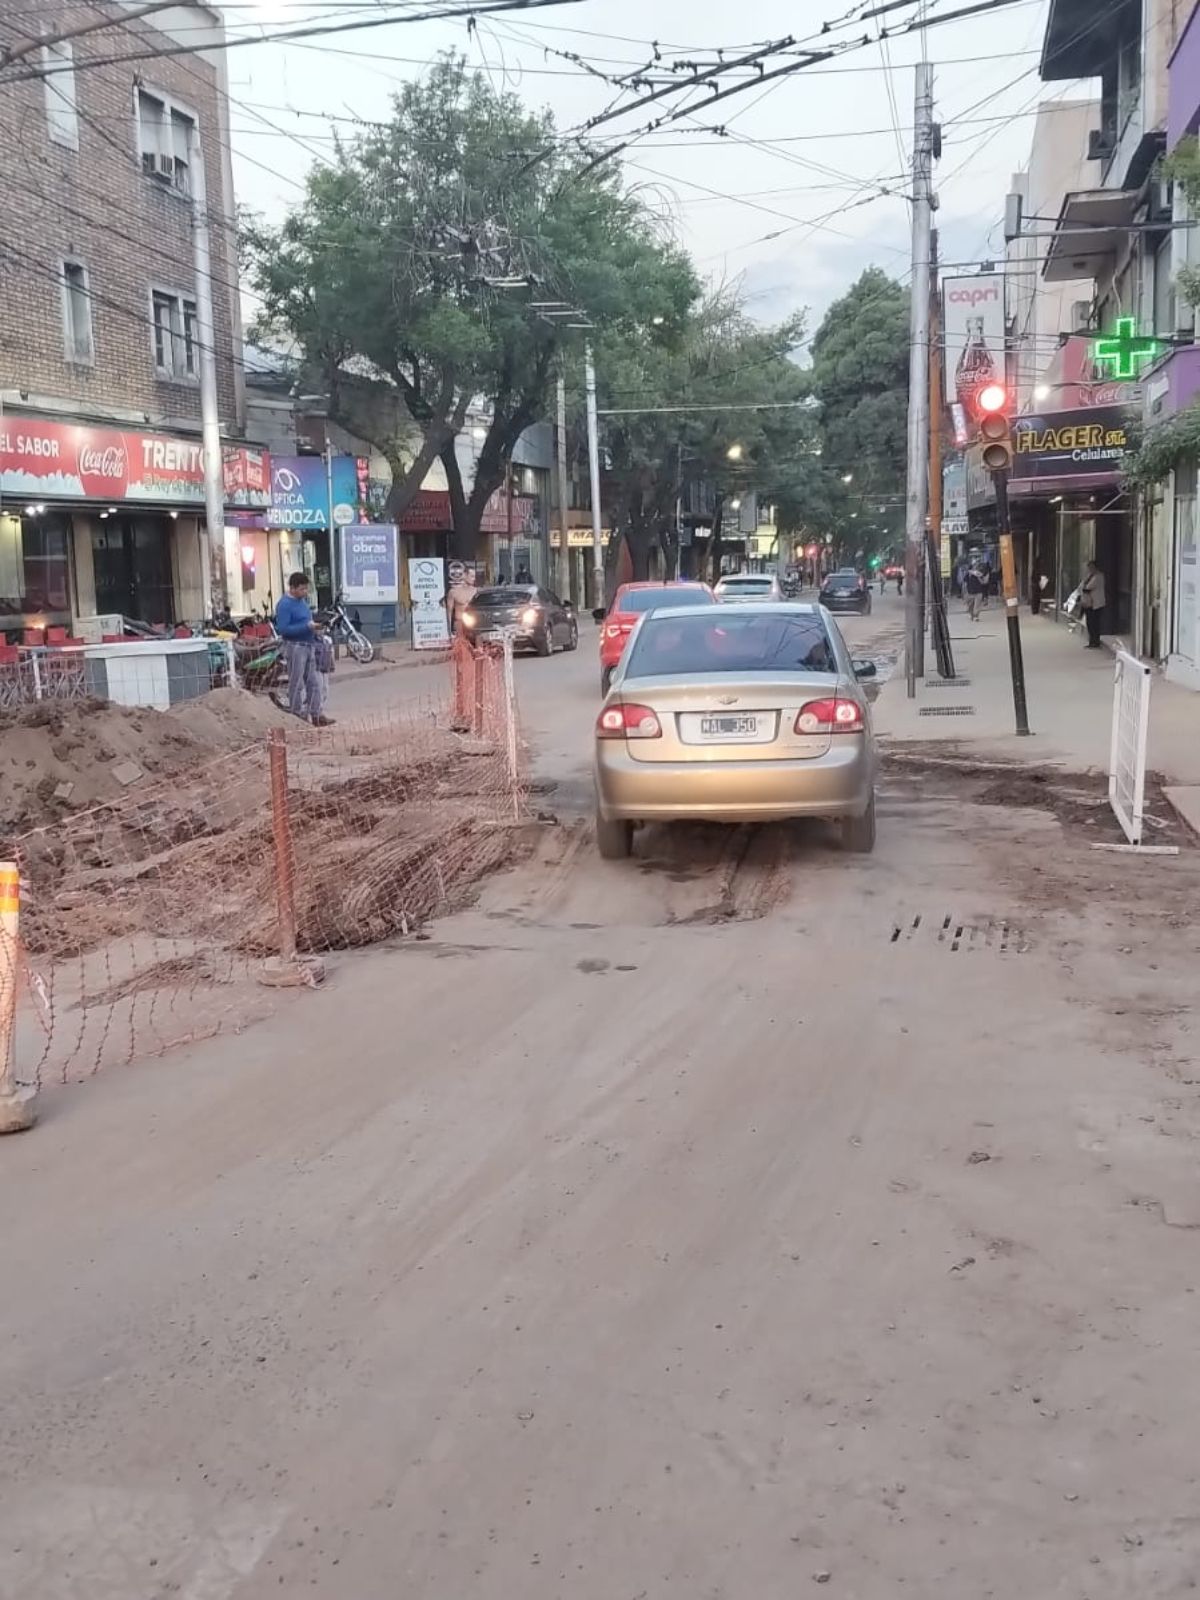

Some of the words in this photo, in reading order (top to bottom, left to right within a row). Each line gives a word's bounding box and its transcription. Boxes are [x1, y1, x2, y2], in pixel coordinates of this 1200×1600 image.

[949, 288, 998, 308] capri
[17, 436, 60, 458] SABOR
[1017, 424, 1104, 453] FLAGER
[1071, 448, 1124, 461] Celulares
[267, 508, 326, 524] MENDOZA
[353, 542, 387, 553] obras
